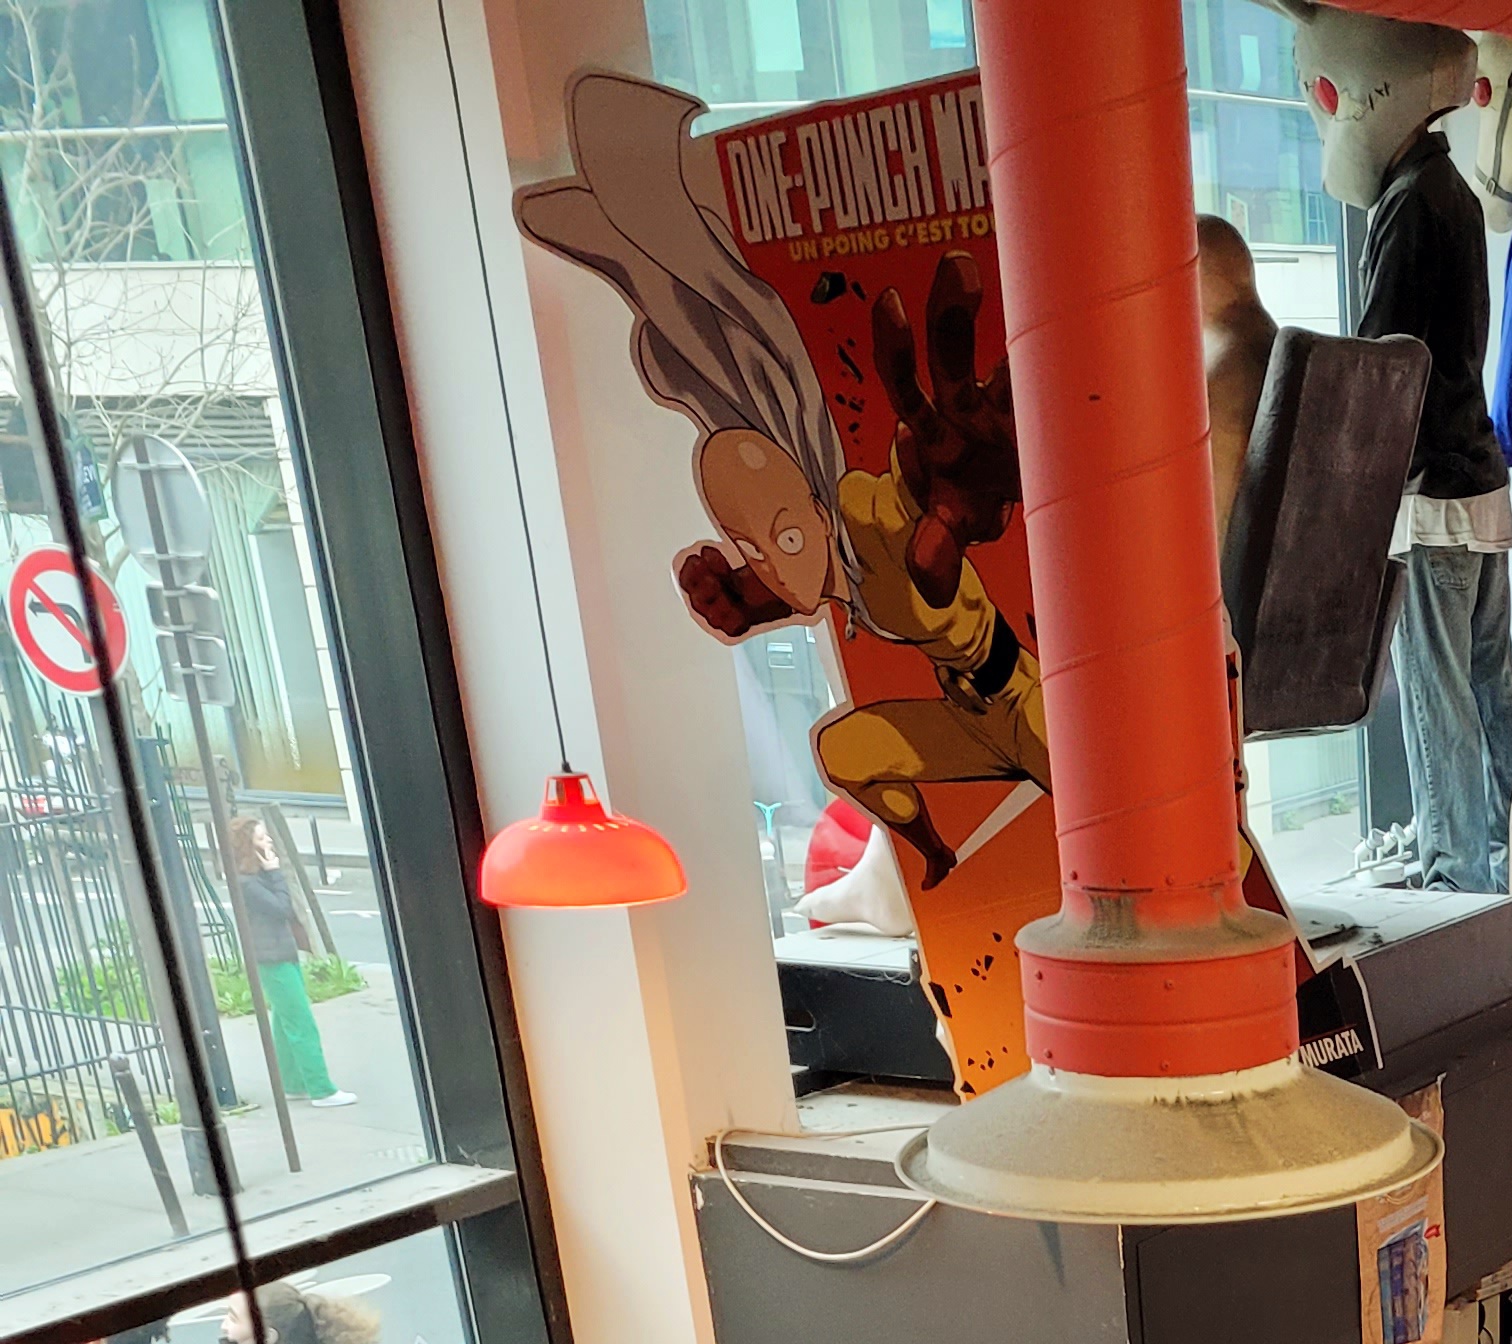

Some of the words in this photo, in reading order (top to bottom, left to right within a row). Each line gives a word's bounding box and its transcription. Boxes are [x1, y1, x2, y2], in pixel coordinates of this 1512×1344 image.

[726, 101, 936, 244] ONE-PUNCH
[930, 85, 993, 212] MA
[789, 241, 818, 262] UN
[823, 226, 890, 257] POING
[895, 220, 952, 247] C'EST
[1301, 1028, 1364, 1067] MURATA
